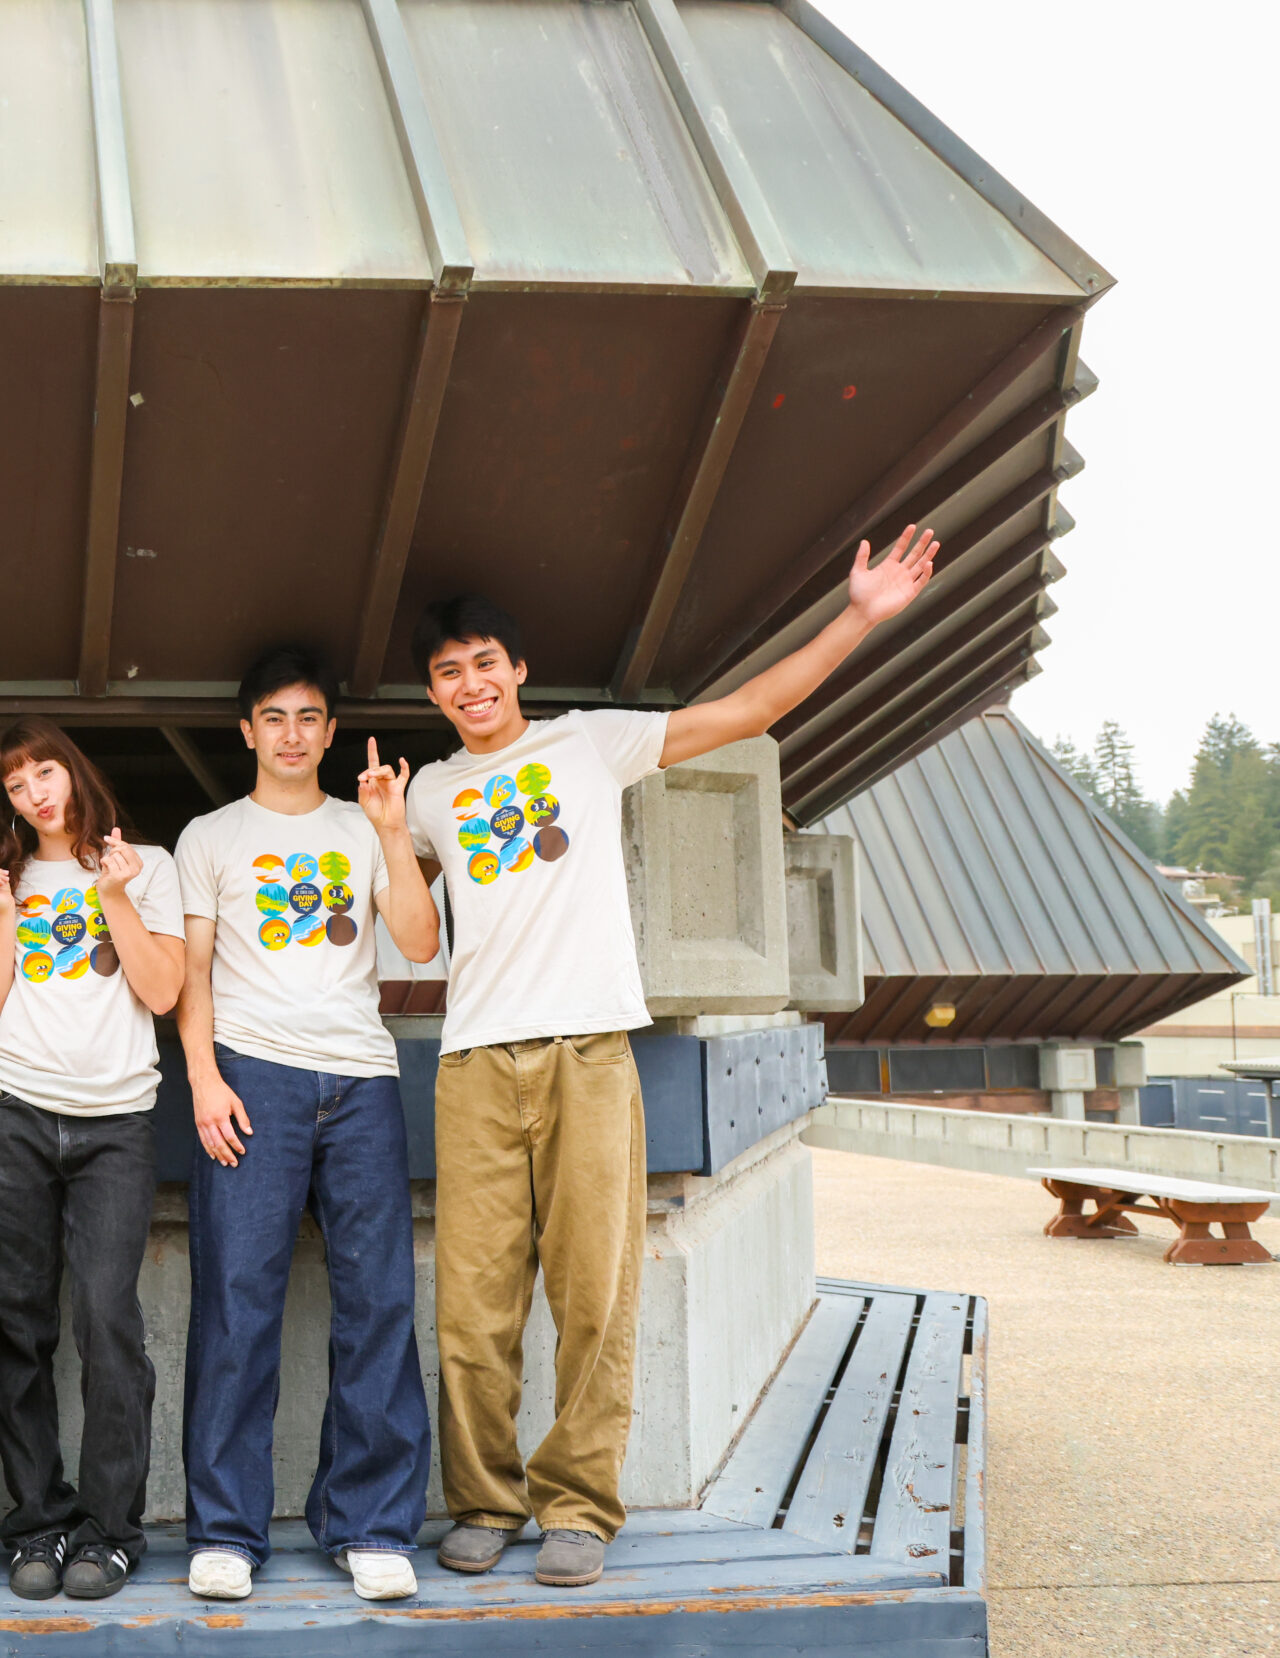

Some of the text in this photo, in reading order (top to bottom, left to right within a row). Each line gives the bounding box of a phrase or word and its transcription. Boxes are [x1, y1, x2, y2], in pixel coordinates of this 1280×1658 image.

[495, 814, 520, 828] GIVING
[502, 822, 515, 832] DAY
[56, 923, 82, 932] GIVING
[62, 929, 77, 938] DAY
